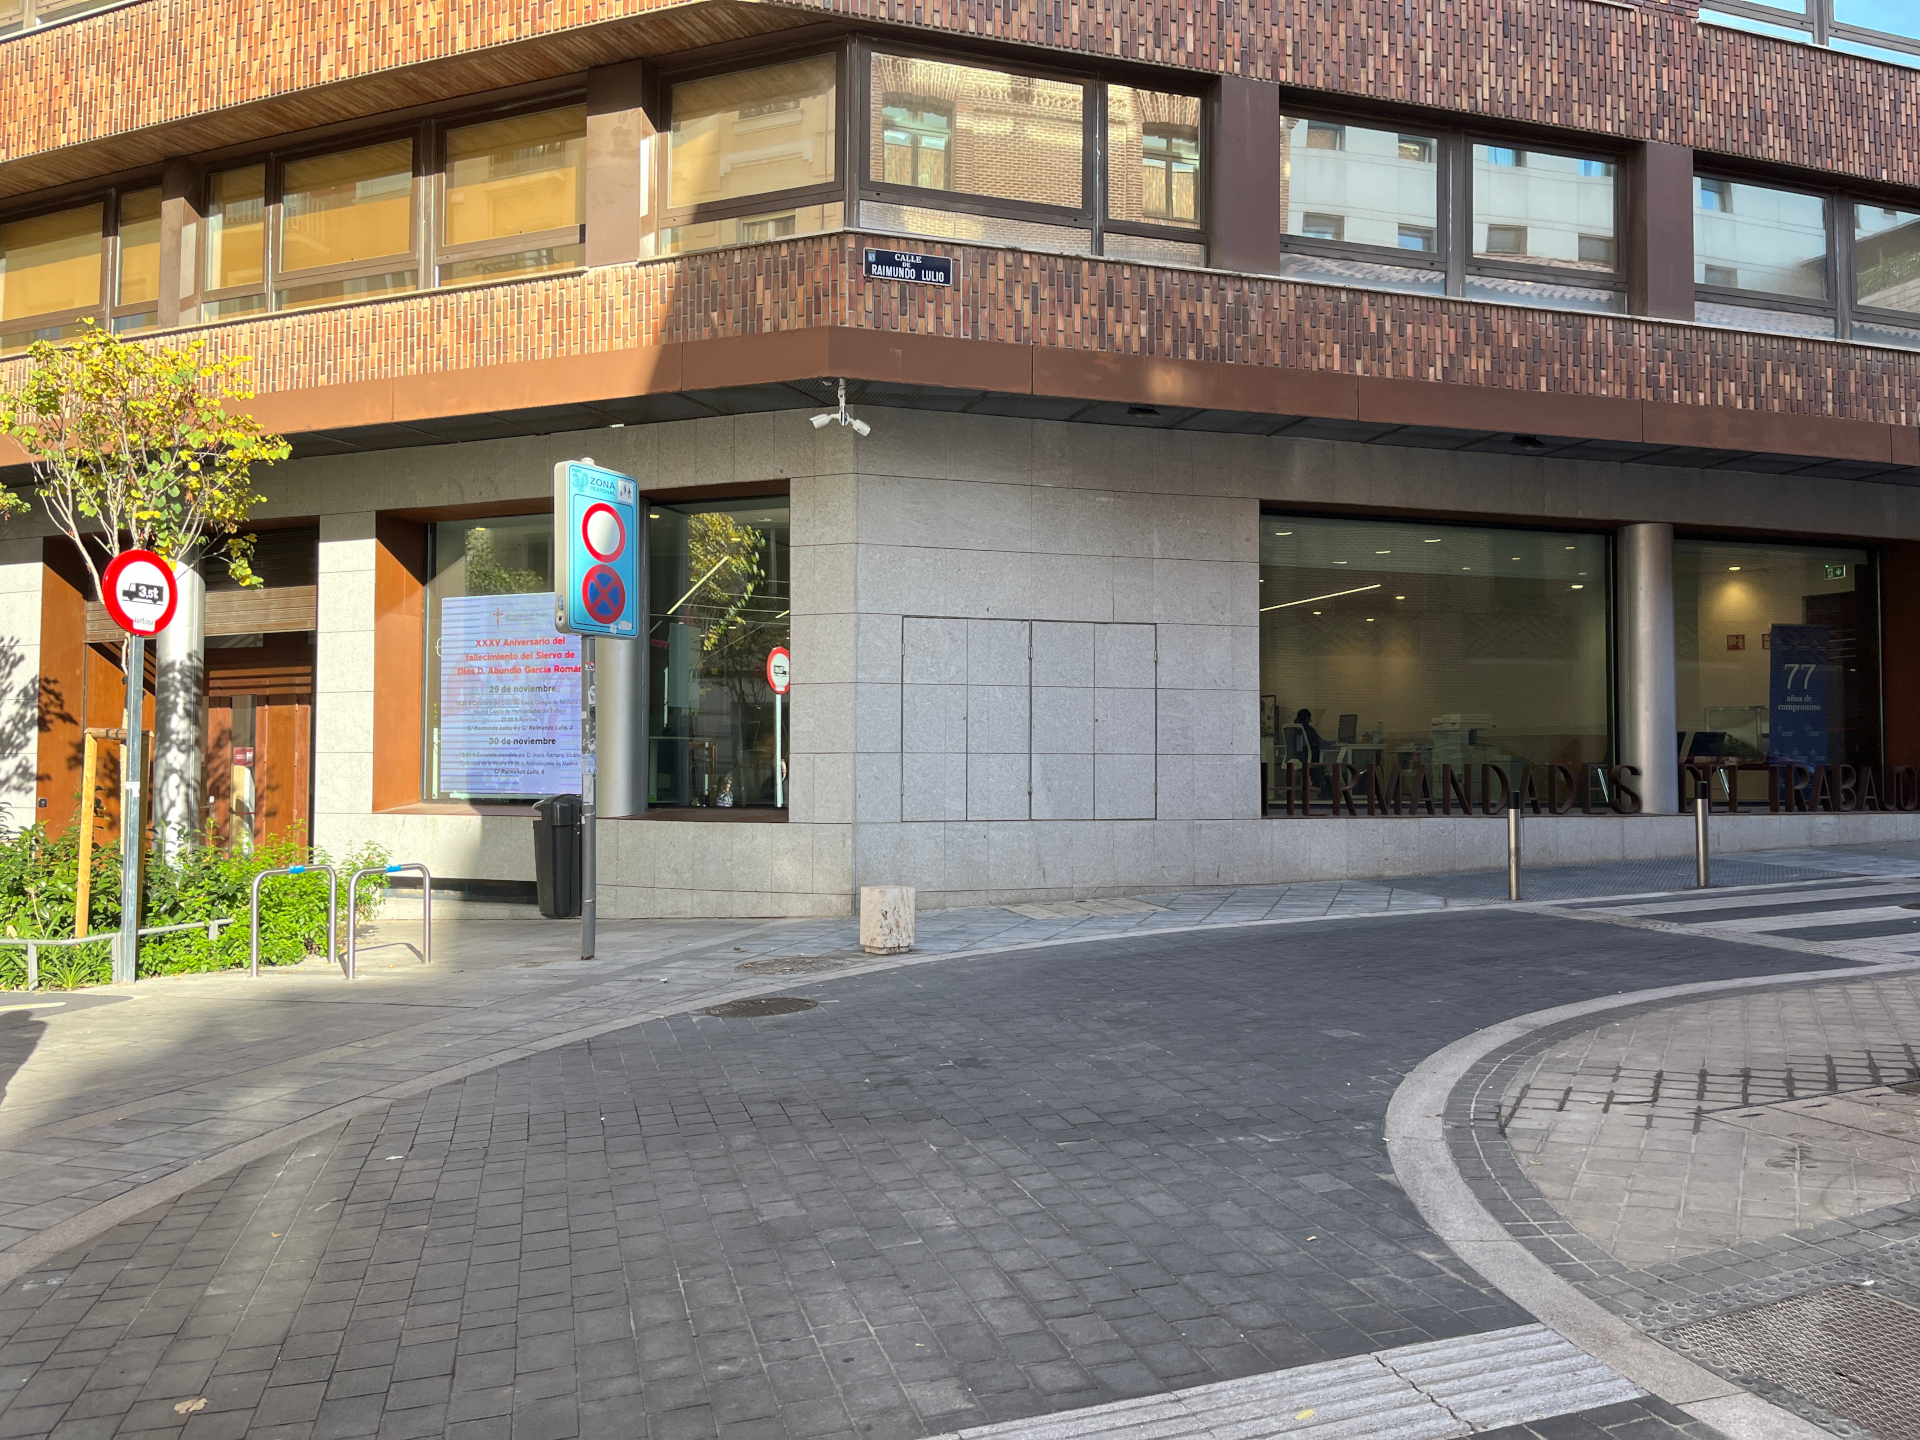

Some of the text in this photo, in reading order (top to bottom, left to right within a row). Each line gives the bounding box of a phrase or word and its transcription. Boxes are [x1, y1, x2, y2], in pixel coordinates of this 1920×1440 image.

[894, 253, 922, 264] CALLE
[871, 264, 944, 282] RAIMUNDO LULIO
[590, 476, 615, 490] ZONA
[590, 486, 615, 496] PEATONAL
[475, 637, 566, 647] XXXV Aniversario del
[465, 651, 575, 661] fallecimiento del Siervo de
[477, 667, 485, 675] D.
[488, 667, 522, 675] Abundio
[1784, 663, 1817, 690] 77
[513, 685, 557, 693] noviembre
[1786, 694, 1813, 703] años de
[1777, 702, 1822, 713] compromiso
[489, 736, 557, 745] 30 de noviembre
[1261, 762, 1642, 817] HERMANDADES
[1770, 763, 1919, 812] TRABAJO
